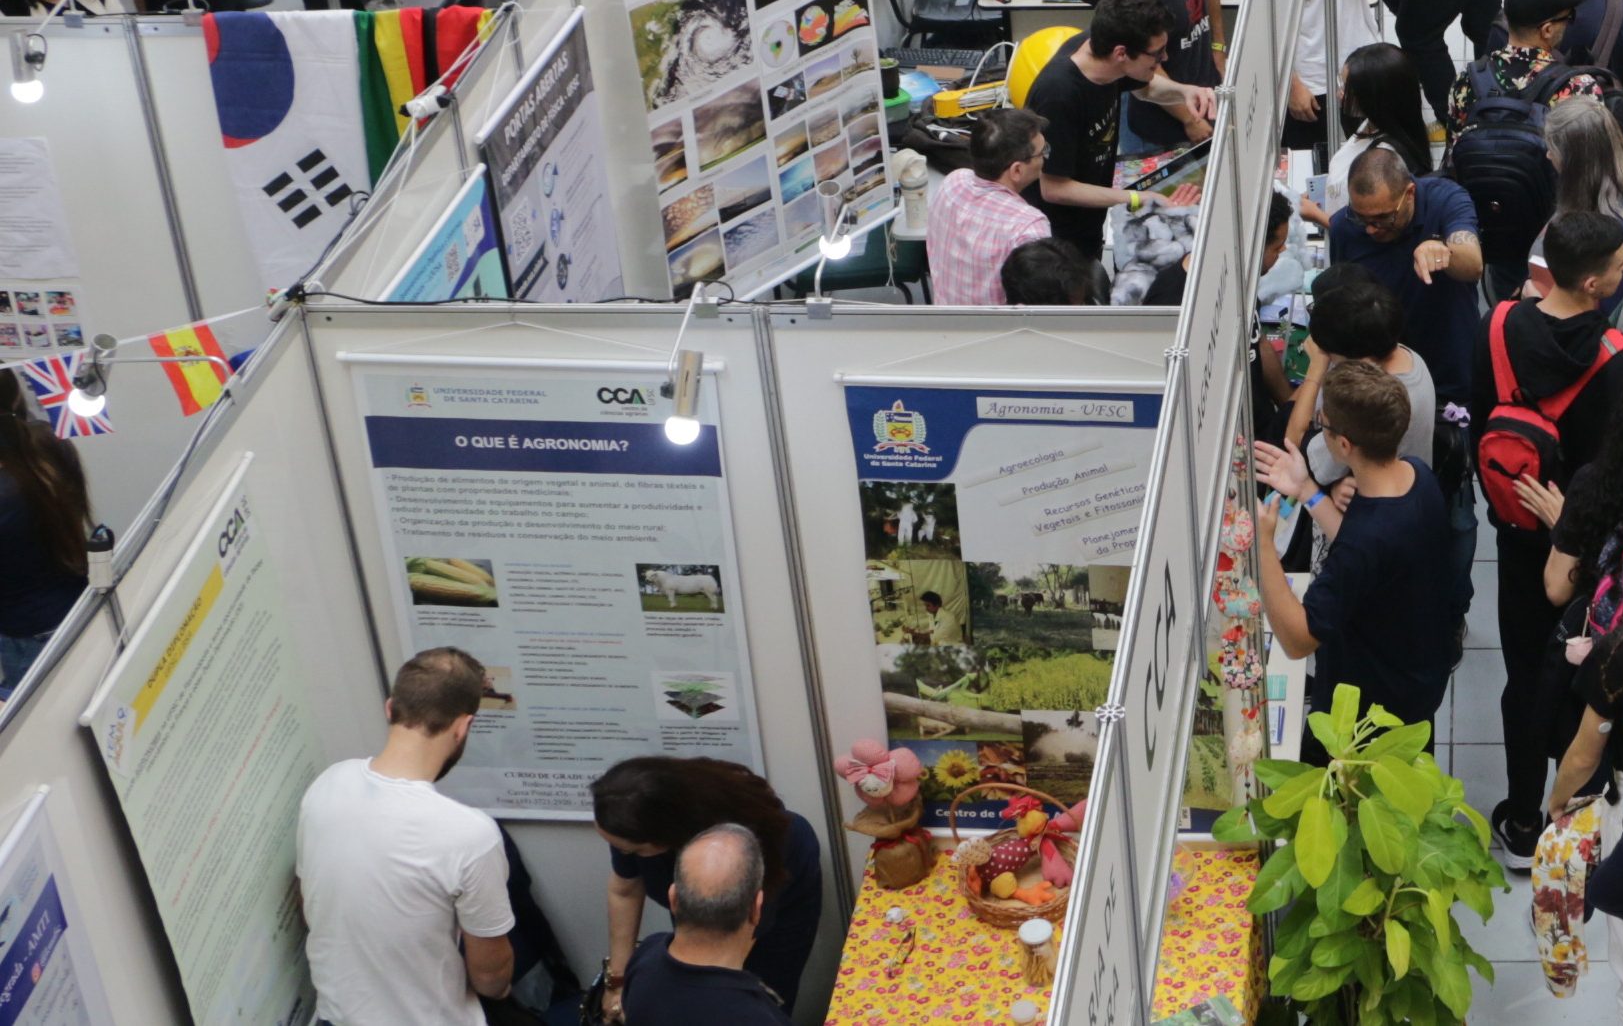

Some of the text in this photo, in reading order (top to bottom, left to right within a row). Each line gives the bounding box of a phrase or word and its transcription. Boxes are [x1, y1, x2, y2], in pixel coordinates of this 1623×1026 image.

[503, 50, 569, 146] PORTAS ABERTAS
[1196, 251, 1229, 443] AGRONOMIA
[433, 387, 547, 398] UNIVERSIDADE FEDERAL
[444, 395, 540, 405] DE SANTA CATARINA
[597, 386, 646, 406] CCA
[985, 401, 1129, 418] Agronomia UFSC
[455, 434, 630, 453] O QUE É AGRONOMIA?
[863, 453, 943, 463] Universidade Federal
[998, 449, 1065, 475] Agroecologia
[1021, 464, 1109, 496] Produção Animal
[1043, 483, 1146, 517] Recursos Genéticos
[1034, 514, 1081, 532] Vegetais
[1084, 510, 1092, 518] e
[218, 507, 246, 559] CCA
[1096, 547, 1109, 556] da
[1143, 558, 1179, 773] CCA
[935, 809, 995, 819] Centro de
